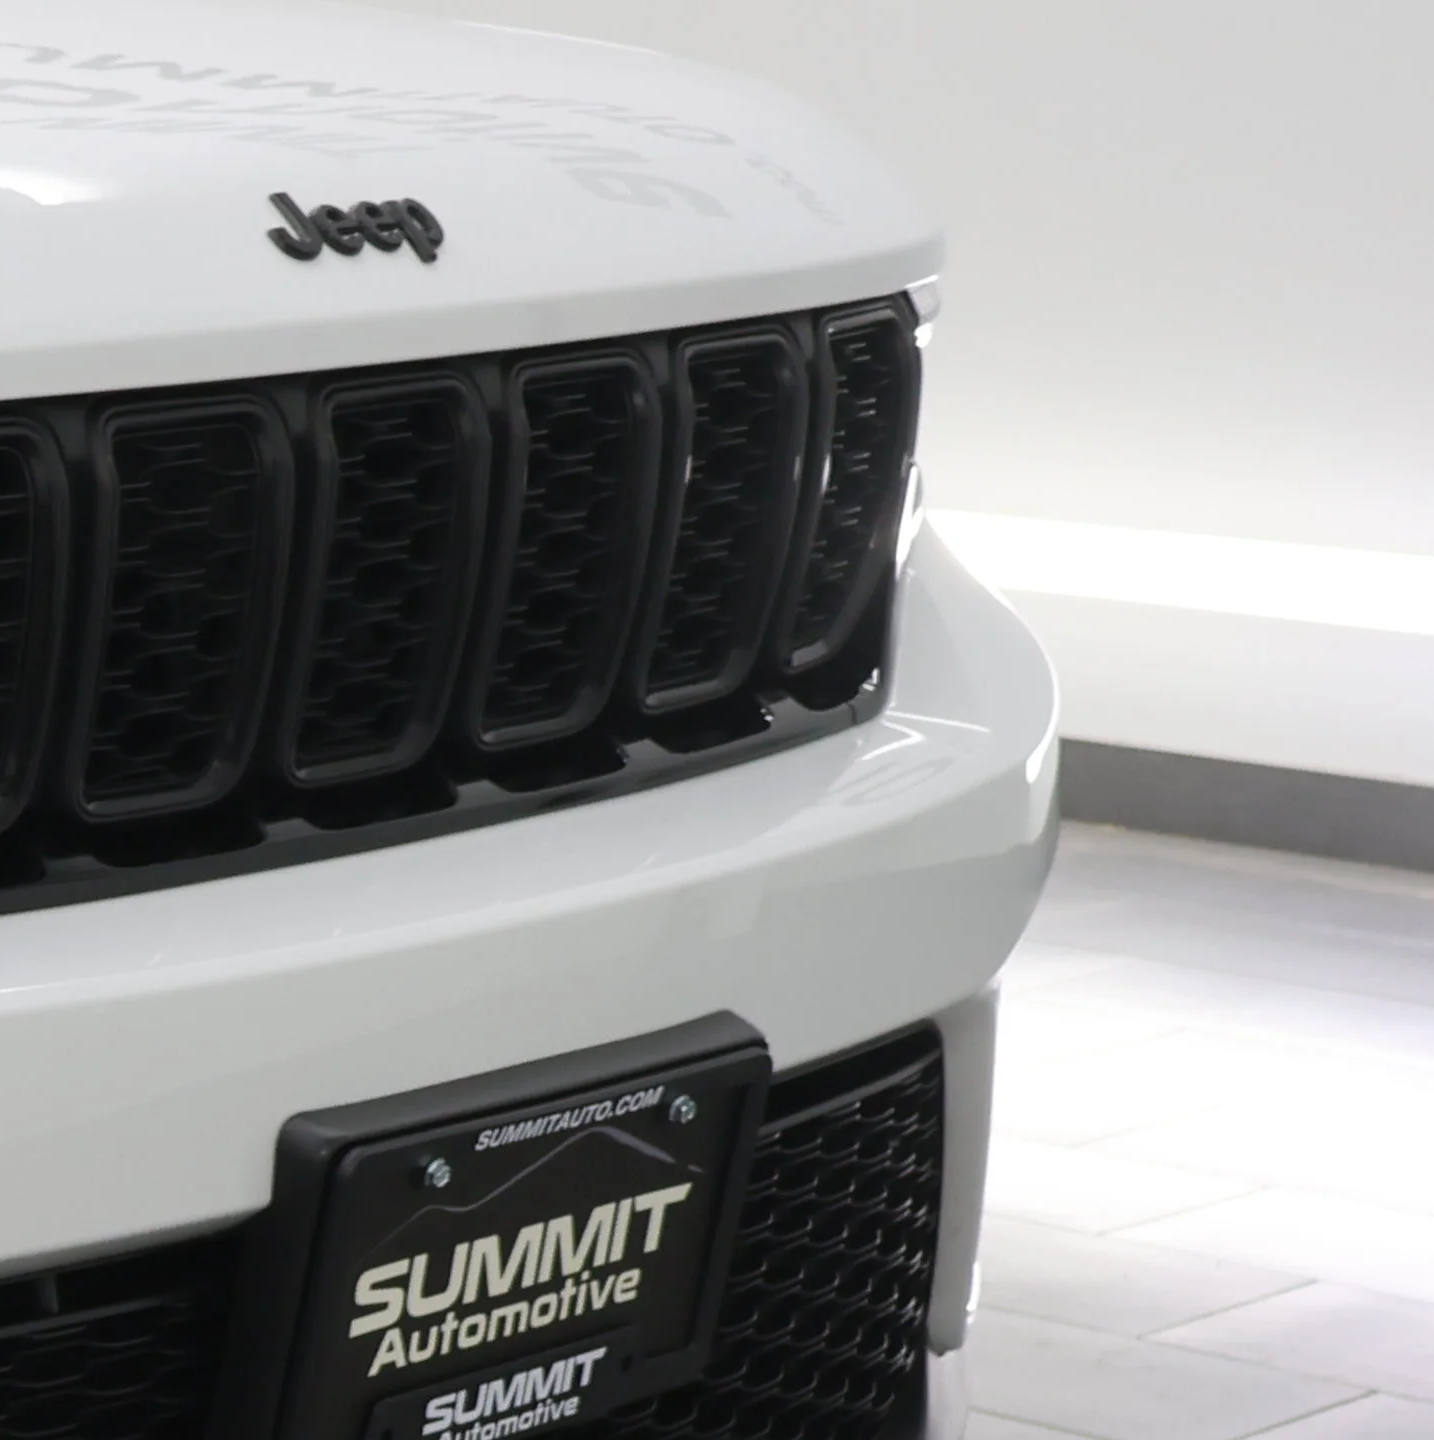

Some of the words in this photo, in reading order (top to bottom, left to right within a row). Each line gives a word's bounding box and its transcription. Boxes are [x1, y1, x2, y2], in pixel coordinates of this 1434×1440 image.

[266, 191, 444, 264] Jeep
[474, 1085, 666, 1151] SUMMITAUTO.COM
[348, 1181, 694, 1339] SUMMIT
[366, 1267, 642, 1378] Automotive
[421, 1346, 608, 1436] SUMMIT
